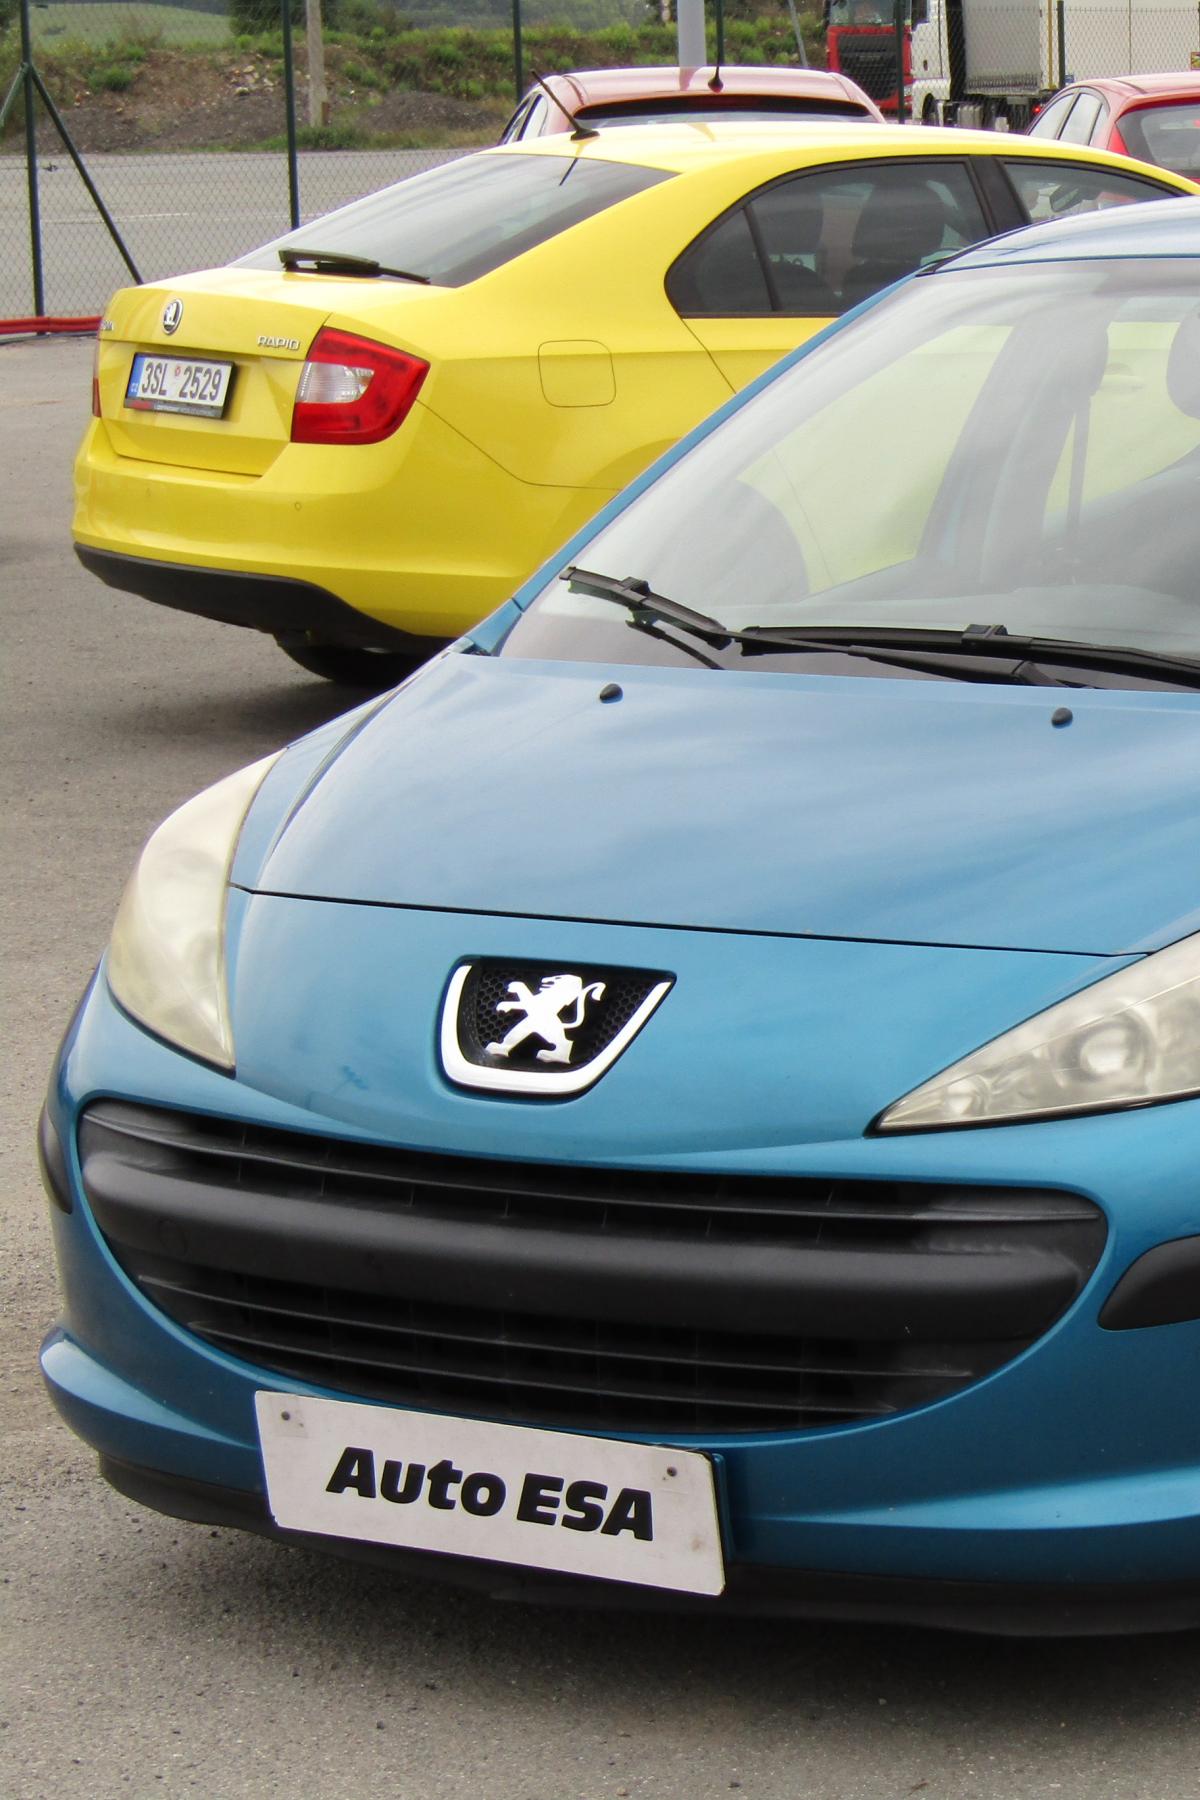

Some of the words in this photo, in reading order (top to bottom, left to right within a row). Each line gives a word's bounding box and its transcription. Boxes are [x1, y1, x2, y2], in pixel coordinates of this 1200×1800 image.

[257, 335, 300, 351] RAPID
[142, 361, 168, 396] 3SL
[179, 365, 222, 402] 2529
[325, 1446, 507, 1517] Auto
[516, 1472, 654, 1542] ESA
